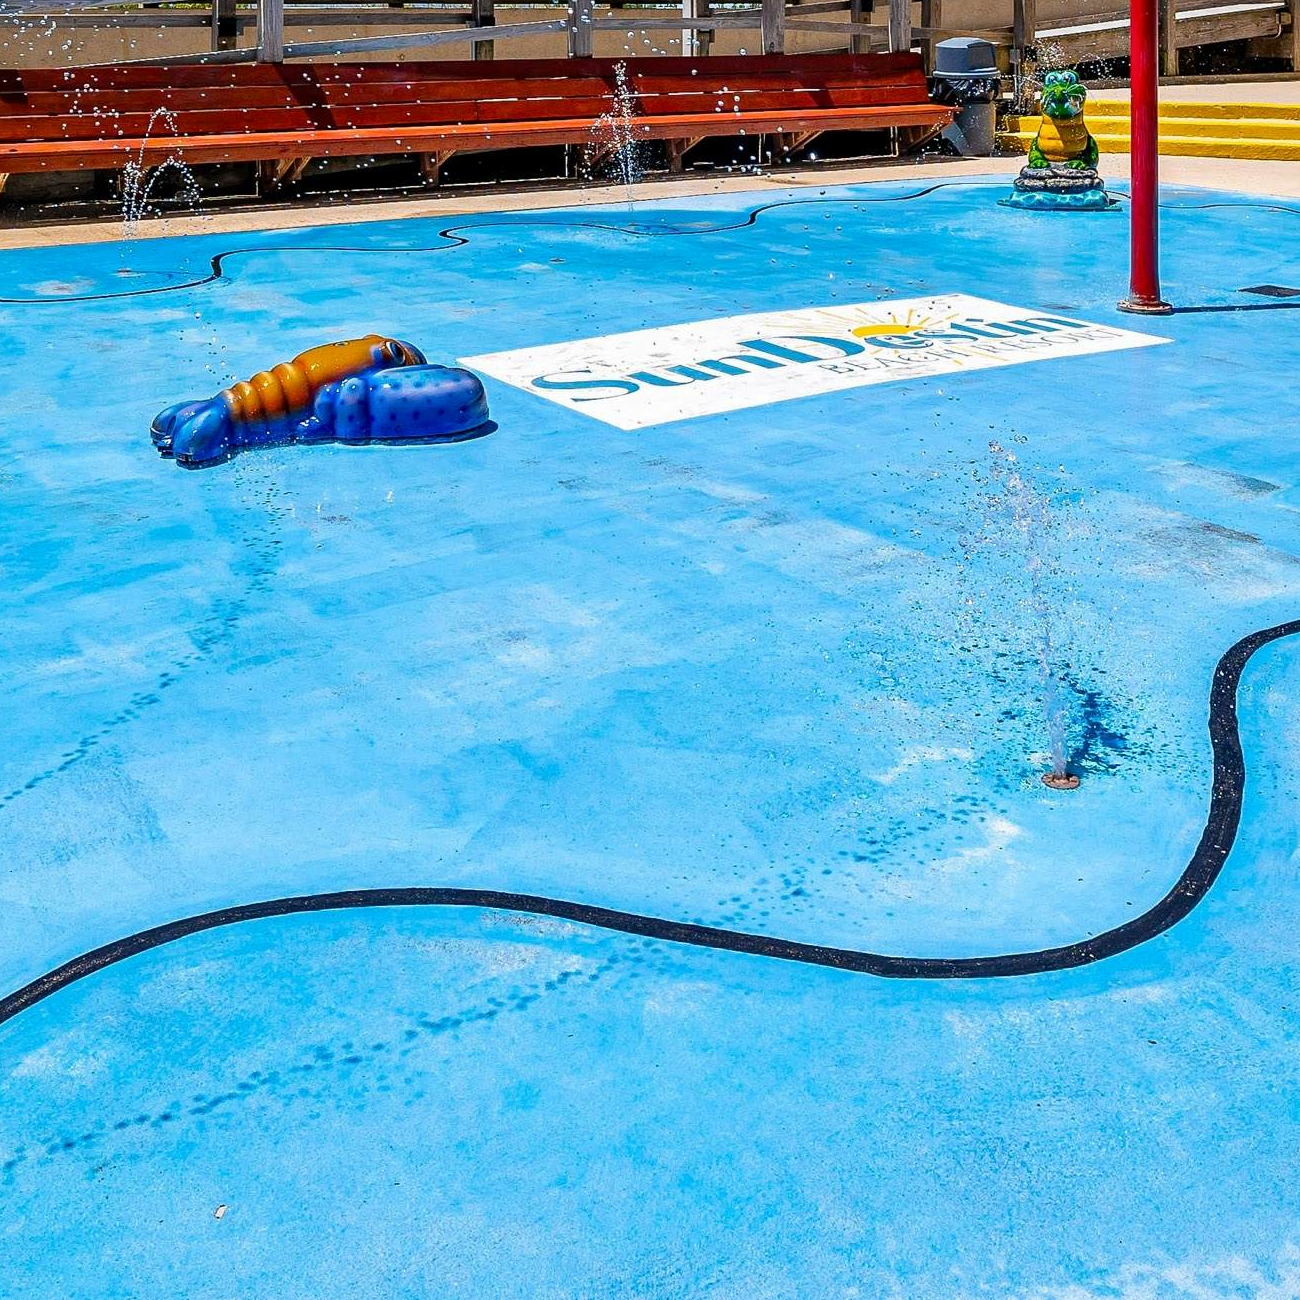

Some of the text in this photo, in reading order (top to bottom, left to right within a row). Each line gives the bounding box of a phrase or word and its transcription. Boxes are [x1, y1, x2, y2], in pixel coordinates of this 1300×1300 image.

[531, 317, 1090, 402] SunDestin
[819, 327, 1124, 375] BEACH RESORT
